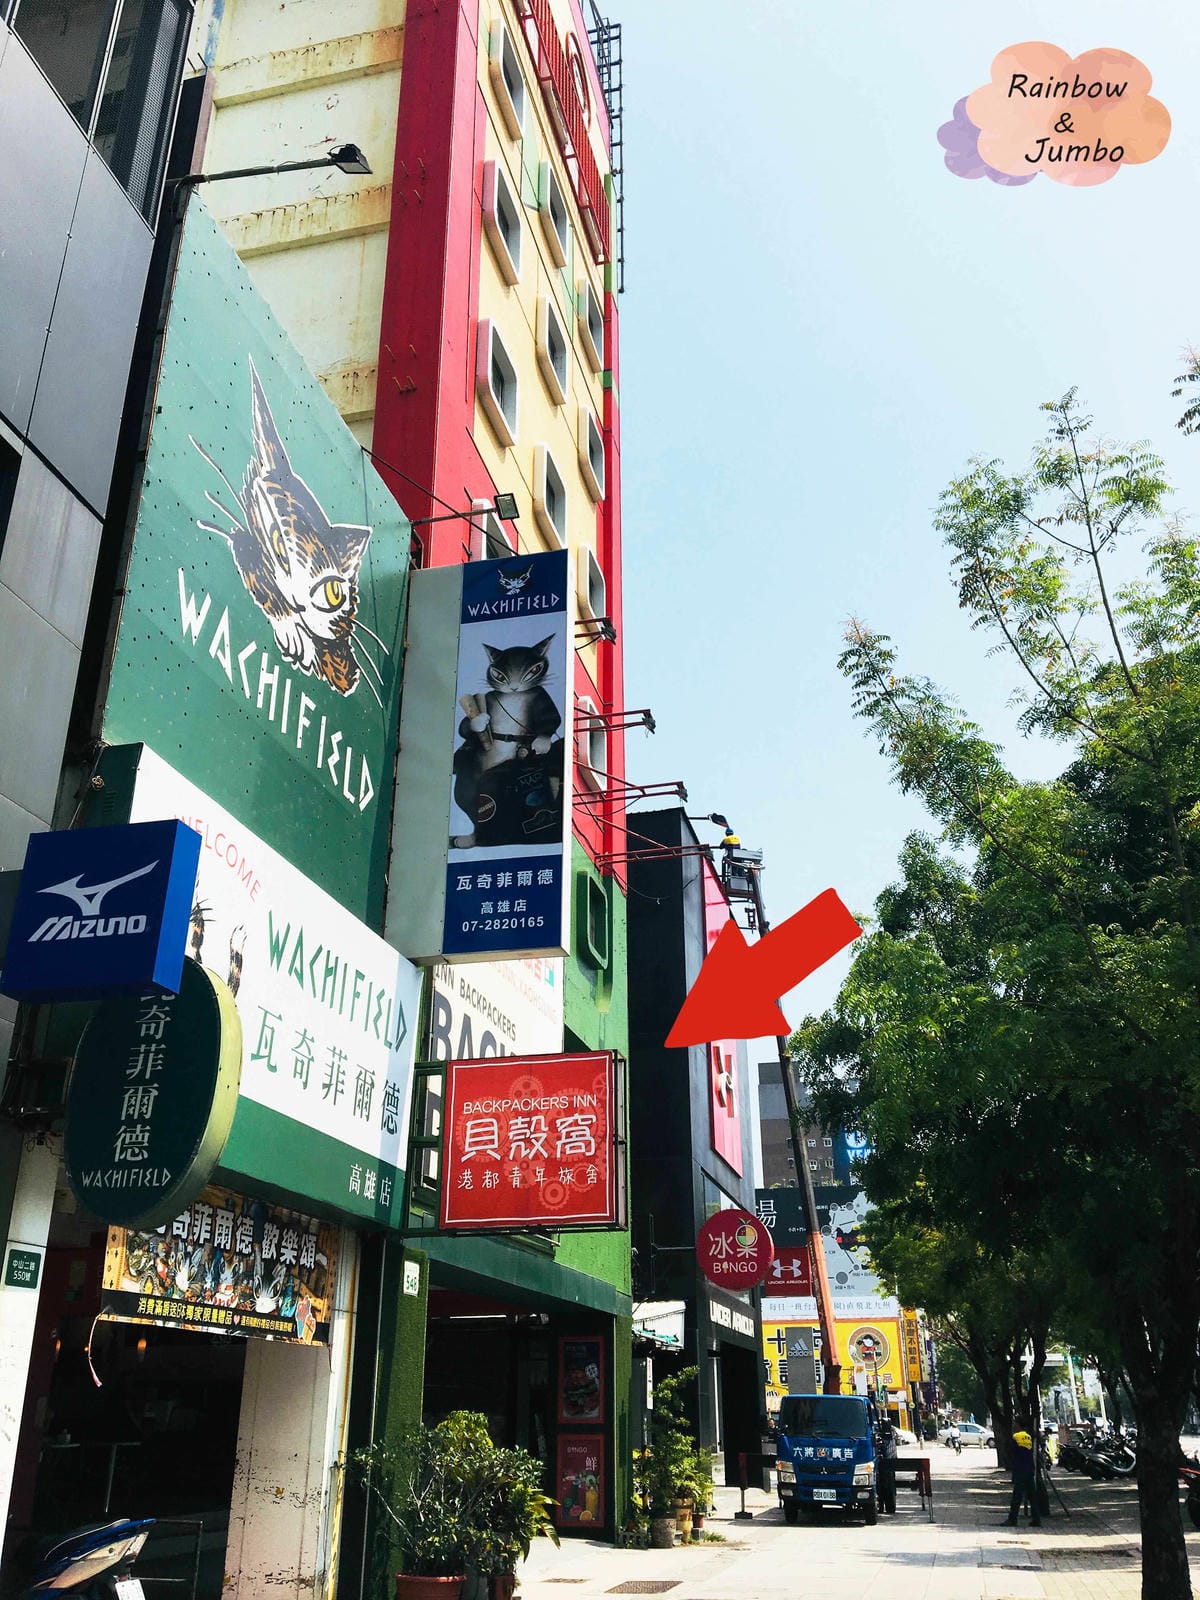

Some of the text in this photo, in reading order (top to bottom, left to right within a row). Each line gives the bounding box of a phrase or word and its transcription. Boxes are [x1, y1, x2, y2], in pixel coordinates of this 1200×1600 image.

[467, 593, 560, 617] WACHIFIELD
[178, 567, 375, 812] WACHIFIELD
[456, 869, 554, 891] 瓦奇菲爾德
[462, 916, 545, 932] 07-2820165
[480, 899, 527, 915] 高雄店
[268, 909, 408, 1053] WACHIFIELD
[459, 978, 517, 1042] BACKPACKERS
[112, 994, 176, 1163] 奇菲爾德
[250, 1005, 401, 1136] 瓦奇菲爾德
[463, 1094, 597, 1114] BACKPACKERS INN
[460, 1112, 597, 1163] 貝殼窩
[81, 1167, 172, 1188] WACHIFIELD
[349, 1163, 392, 1207] 高雄店
[713, 1261, 758, 1275] BINGO
